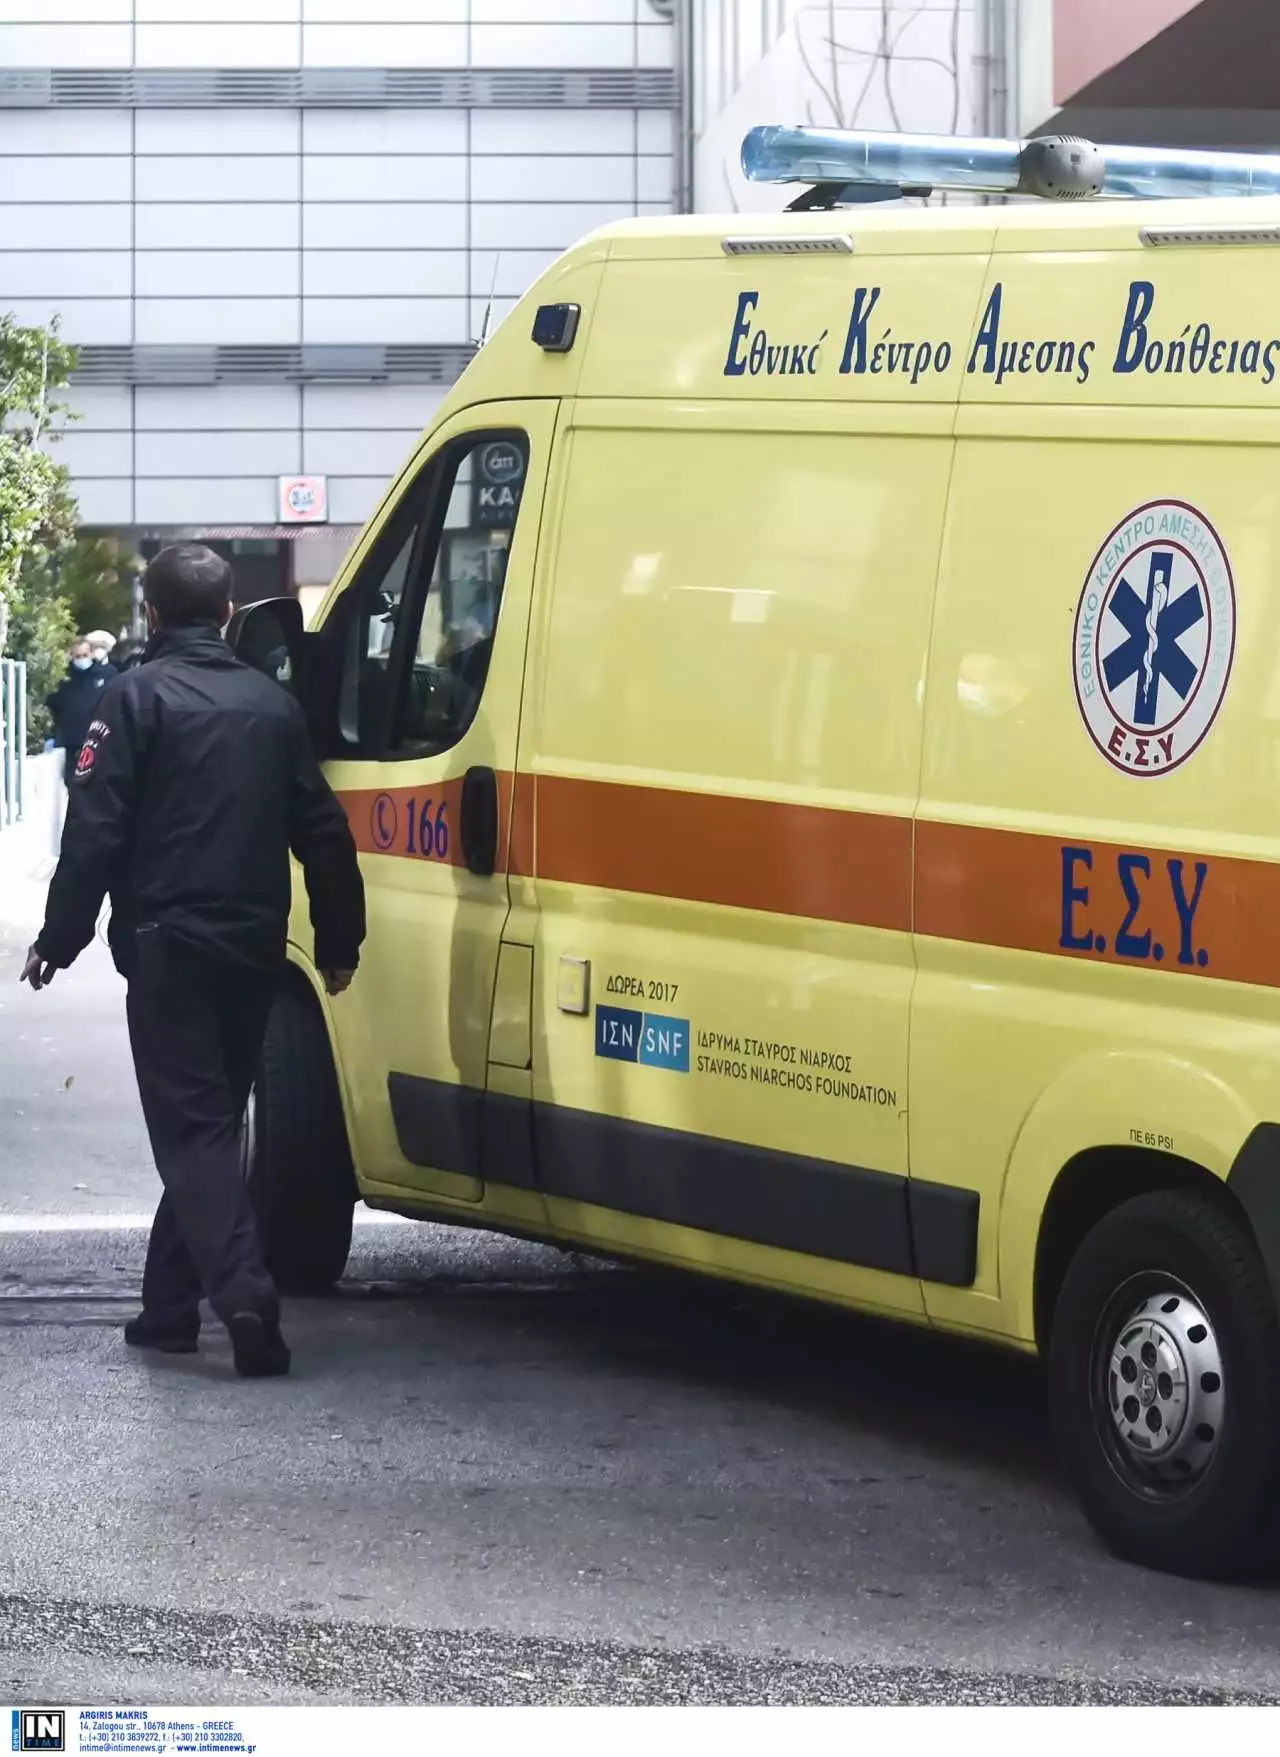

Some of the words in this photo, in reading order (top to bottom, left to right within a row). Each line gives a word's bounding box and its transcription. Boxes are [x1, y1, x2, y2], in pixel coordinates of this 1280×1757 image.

[839, 287, 951, 384] Κέντρο
[967, 282, 1095, 384] Αμεσης
[1080, 593, 1098, 699] ΕΘΝΙΚΟ
[1095, 516, 1154, 587] ΚΕΝΤΡΟ
[1107, 725, 1175, 766] Ε.Σ.Υ
[406, 797, 448, 858] 166
[1058, 846, 1209, 968] Ε.Σ.Υ.
[606, 975, 645, 998] ΔΩΡΕΑ
[649, 981, 679, 1002] 2017
[602, 1019, 634, 1048] ΙΣΝ
[646, 1027, 683, 1057] SNF
[697, 1030, 741, 1054] ΙΔΡΥΜΑ
[744, 1039, 796, 1064] ΣΤΑΥΡΟΣ
[800, 1048, 852, 1073] ΝΙΑΡΧΟΣ
[697, 1055, 747, 1080] STAVROS
[750, 1066, 812, 1092] NIARCHOS
[816, 1076, 897, 1107] FOUNDATION
[1145, 1132, 1156, 1146] 65
[1158, 1134, 1174, 1150] PSI
